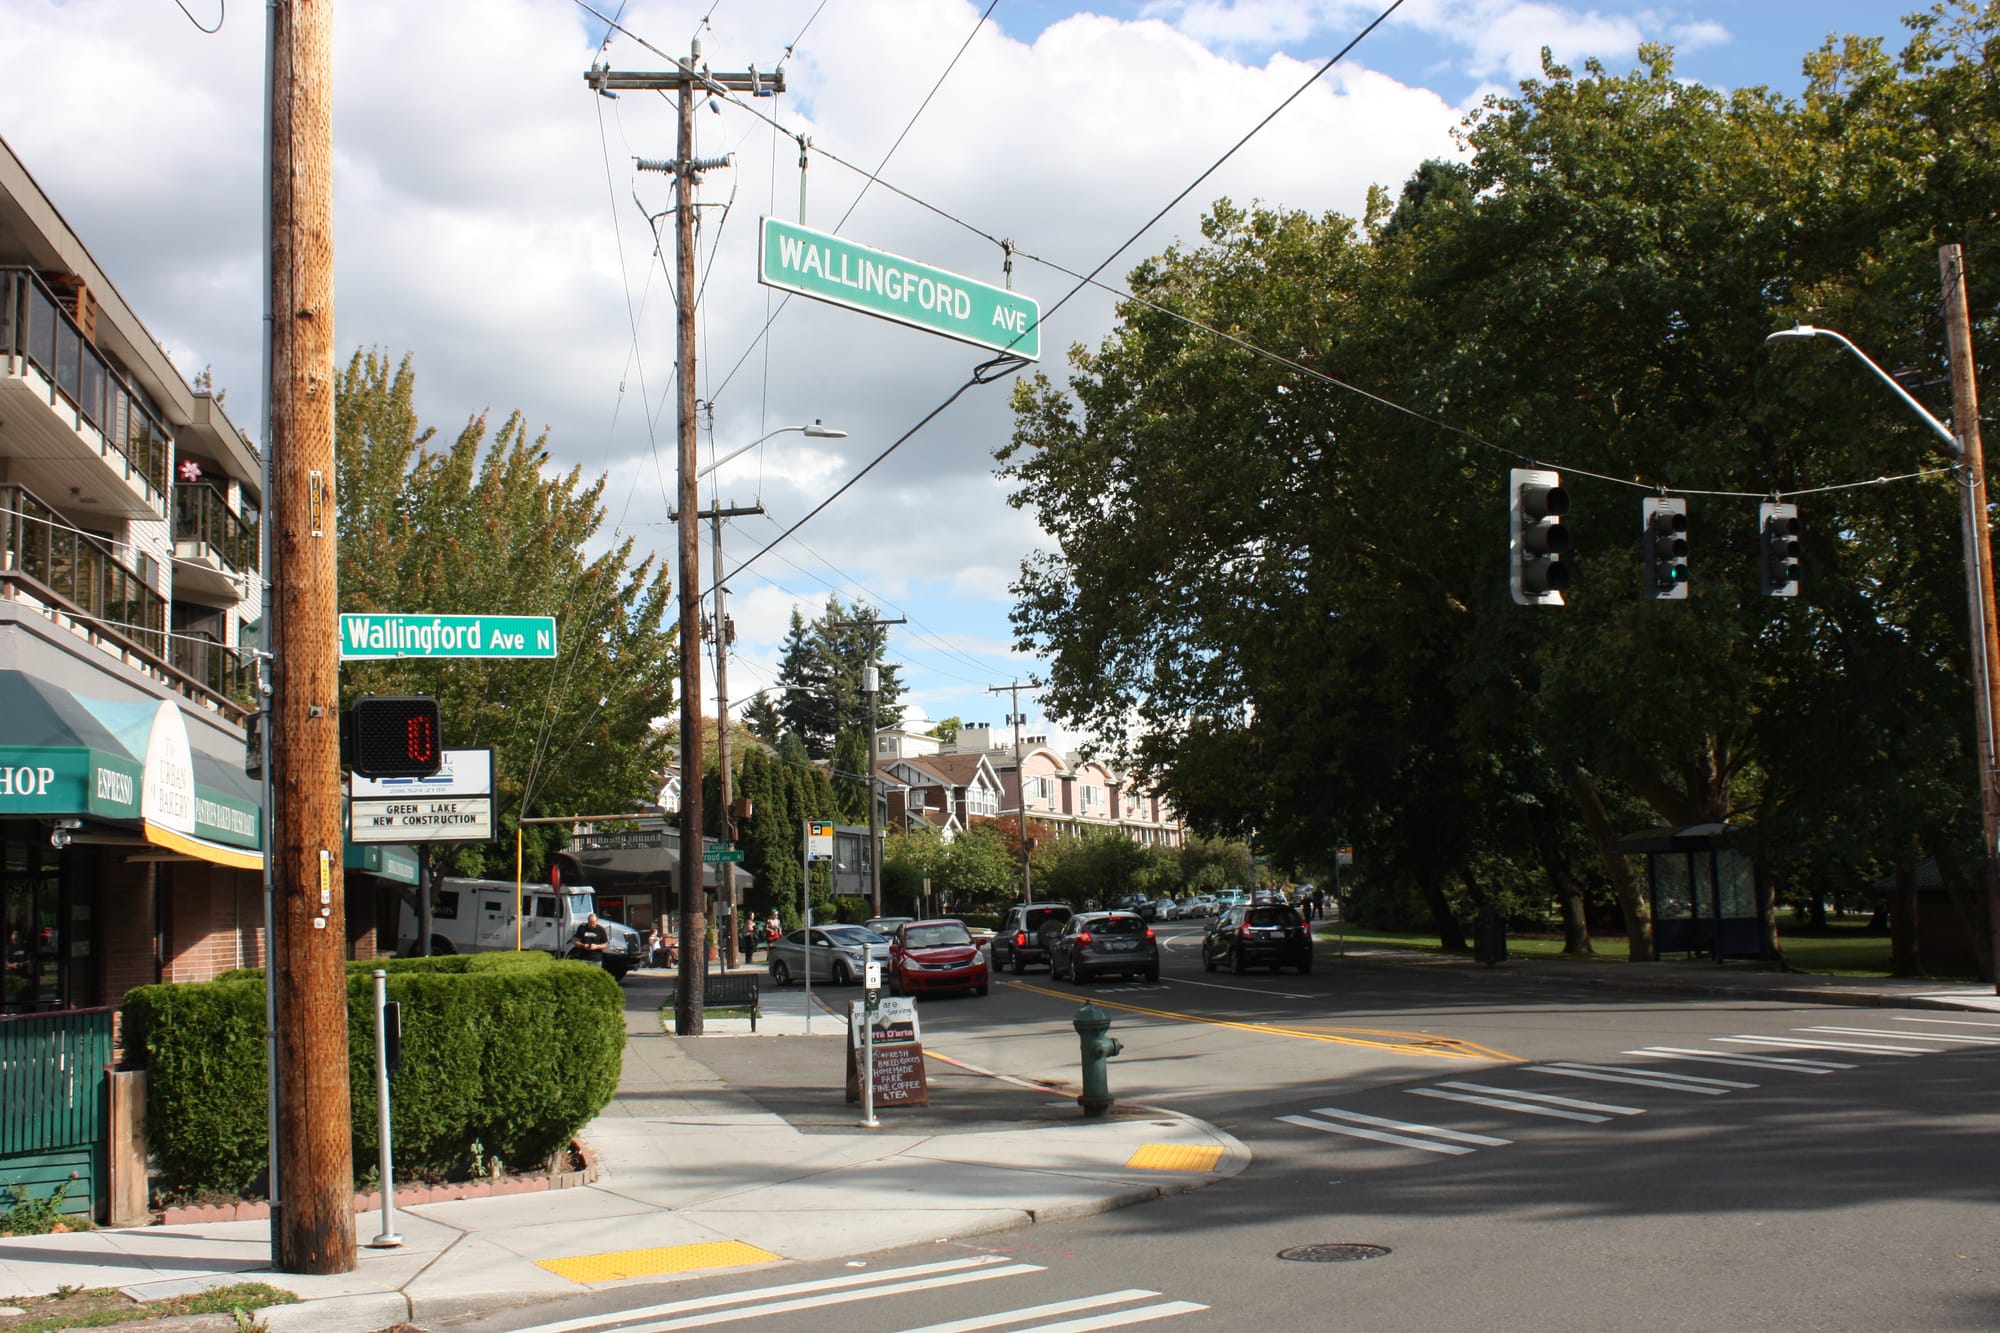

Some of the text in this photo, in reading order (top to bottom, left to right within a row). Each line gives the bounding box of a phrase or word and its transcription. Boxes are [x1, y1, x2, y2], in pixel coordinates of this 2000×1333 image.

[779, 235, 1027, 334] WALLINGFORD AVE
[313, 476, 321, 531] 7802
[347, 617, 550, 654] Wallingford Ave N
[160, 759, 187, 790] URBAN
[97, 767, 133, 805] ESPRESSO
[159, 787, 190, 819] BAKERY
[386, 803, 457, 814] GREEN LAKE
[373, 814, 476, 826] NEW CONSTRUCTION
[885, 1050, 909, 1059] FRESH
[877, 1056, 920, 1068] BAKED GOODS
[873, 1065, 914, 1078] HOMEMADE
[881, 1074, 903, 1083] FARE
[872, 1080, 921, 1093] FINE COFFEE
